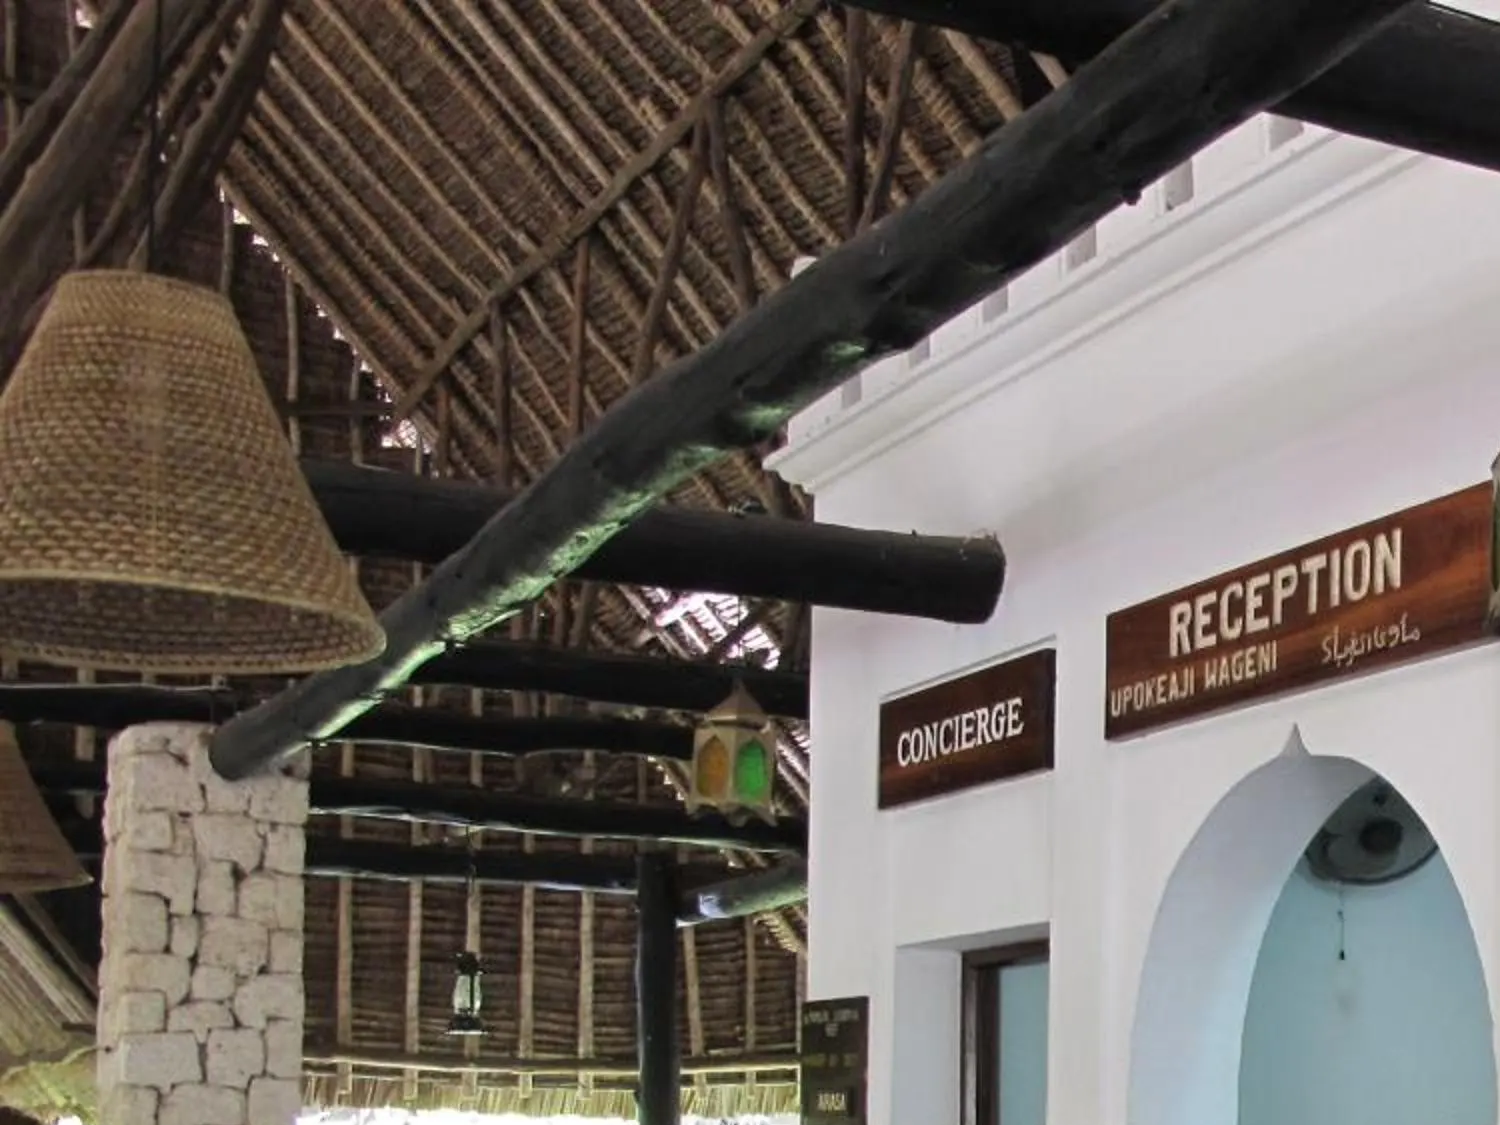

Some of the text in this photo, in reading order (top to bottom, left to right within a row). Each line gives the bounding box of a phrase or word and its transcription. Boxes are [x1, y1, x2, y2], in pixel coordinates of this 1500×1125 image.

[1168, 527, 1402, 659] RECEPTION
[1110, 639, 1278, 718] UPOKEAJI WAGENI
[896, 696, 1025, 768] CONCIERGE
